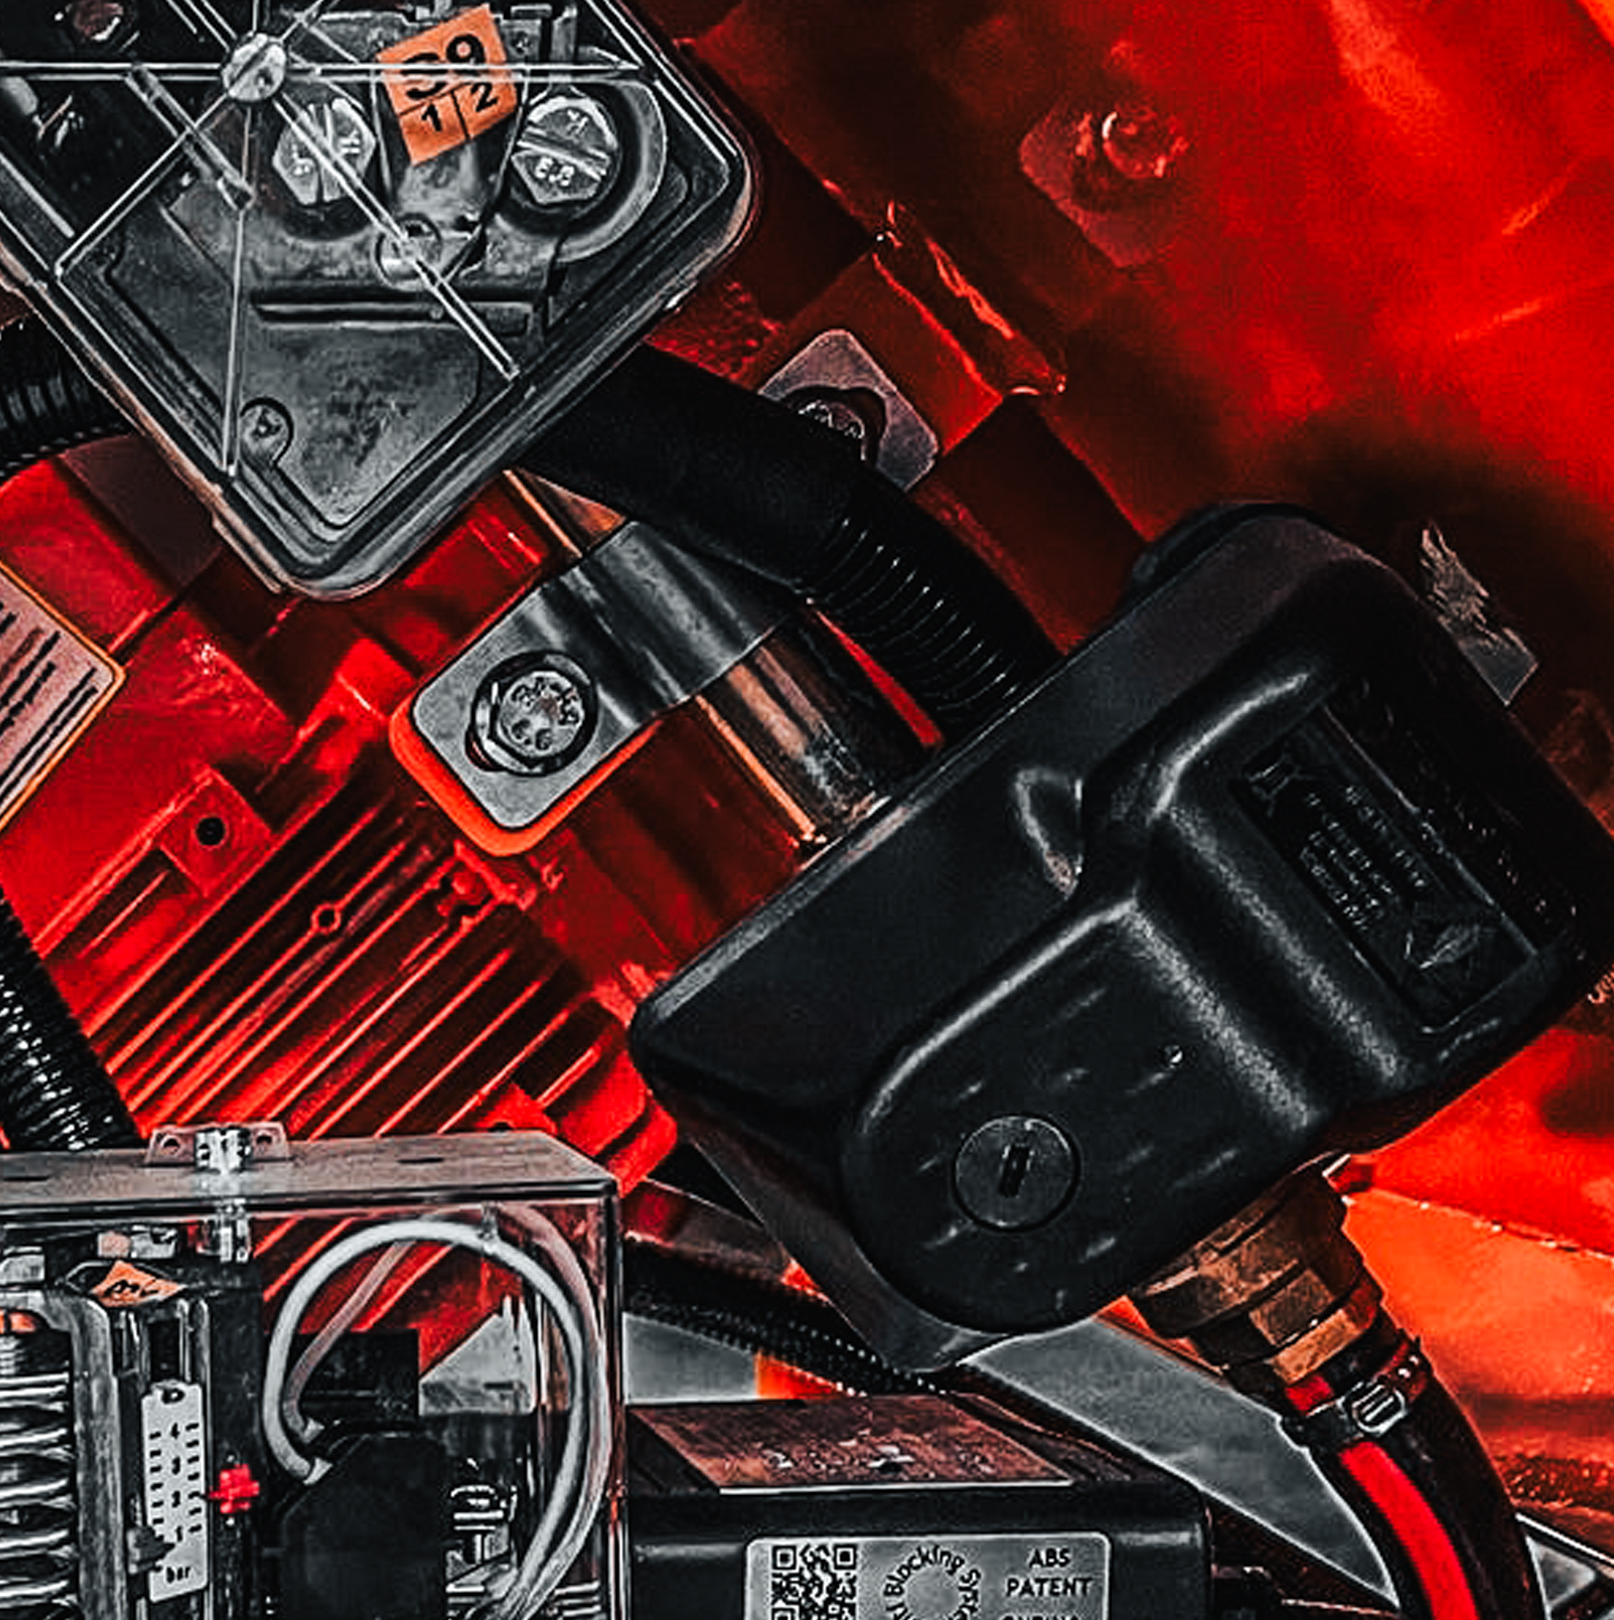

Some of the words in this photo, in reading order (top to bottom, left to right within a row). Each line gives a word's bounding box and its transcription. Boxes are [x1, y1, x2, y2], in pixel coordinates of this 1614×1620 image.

[421, 103, 442, 132] 1
[470, 82, 500, 112] 2
[1028, 1547, 1072, 1569] ABS
[166, 1565, 192, 1583] bar
[883, 1544, 965, 1597] Blocking
[1006, 1577, 1094, 1597] PATENT
